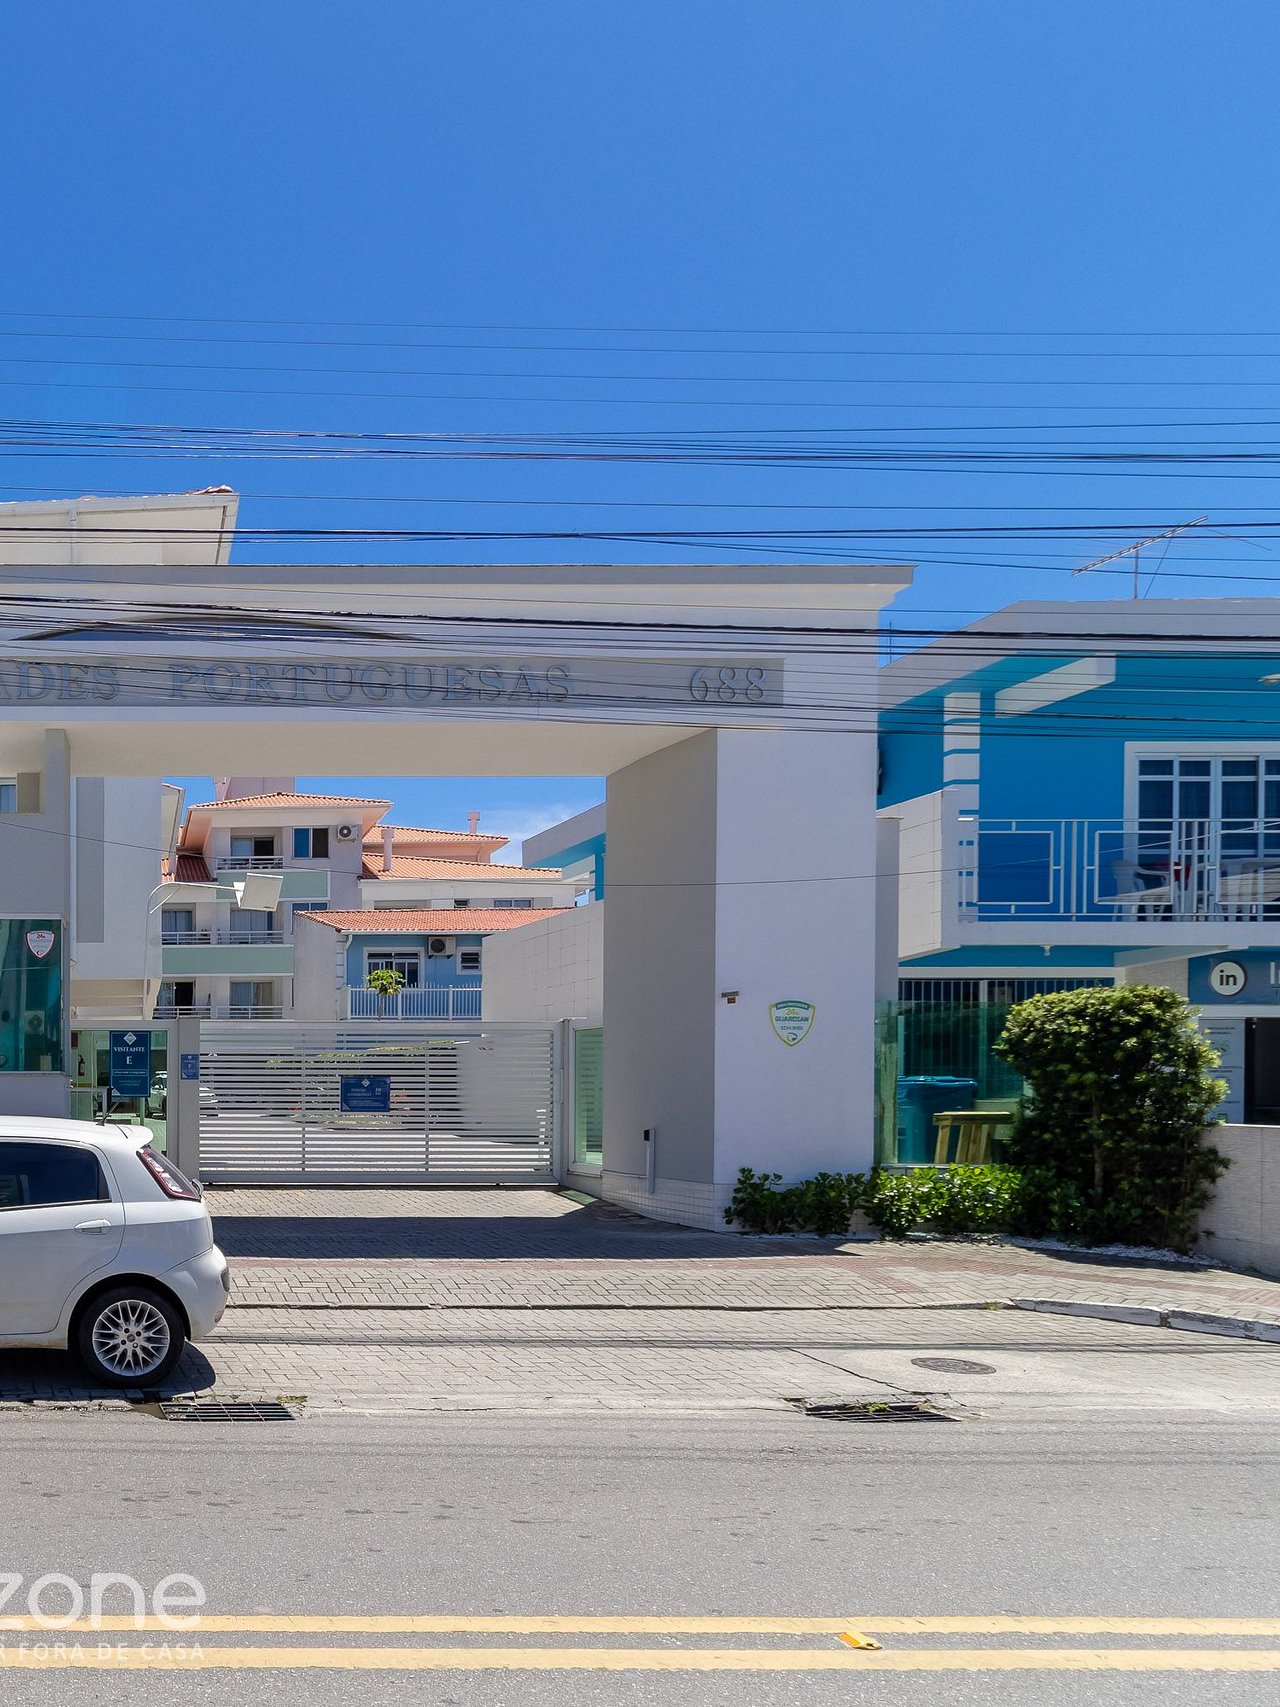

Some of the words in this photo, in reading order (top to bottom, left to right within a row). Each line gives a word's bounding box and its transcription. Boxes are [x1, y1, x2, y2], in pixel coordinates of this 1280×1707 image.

[167, 663, 571, 702] PORTUGUESAS
[689, 664, 767, 702] 688
[1219, 970, 1237, 986] in
